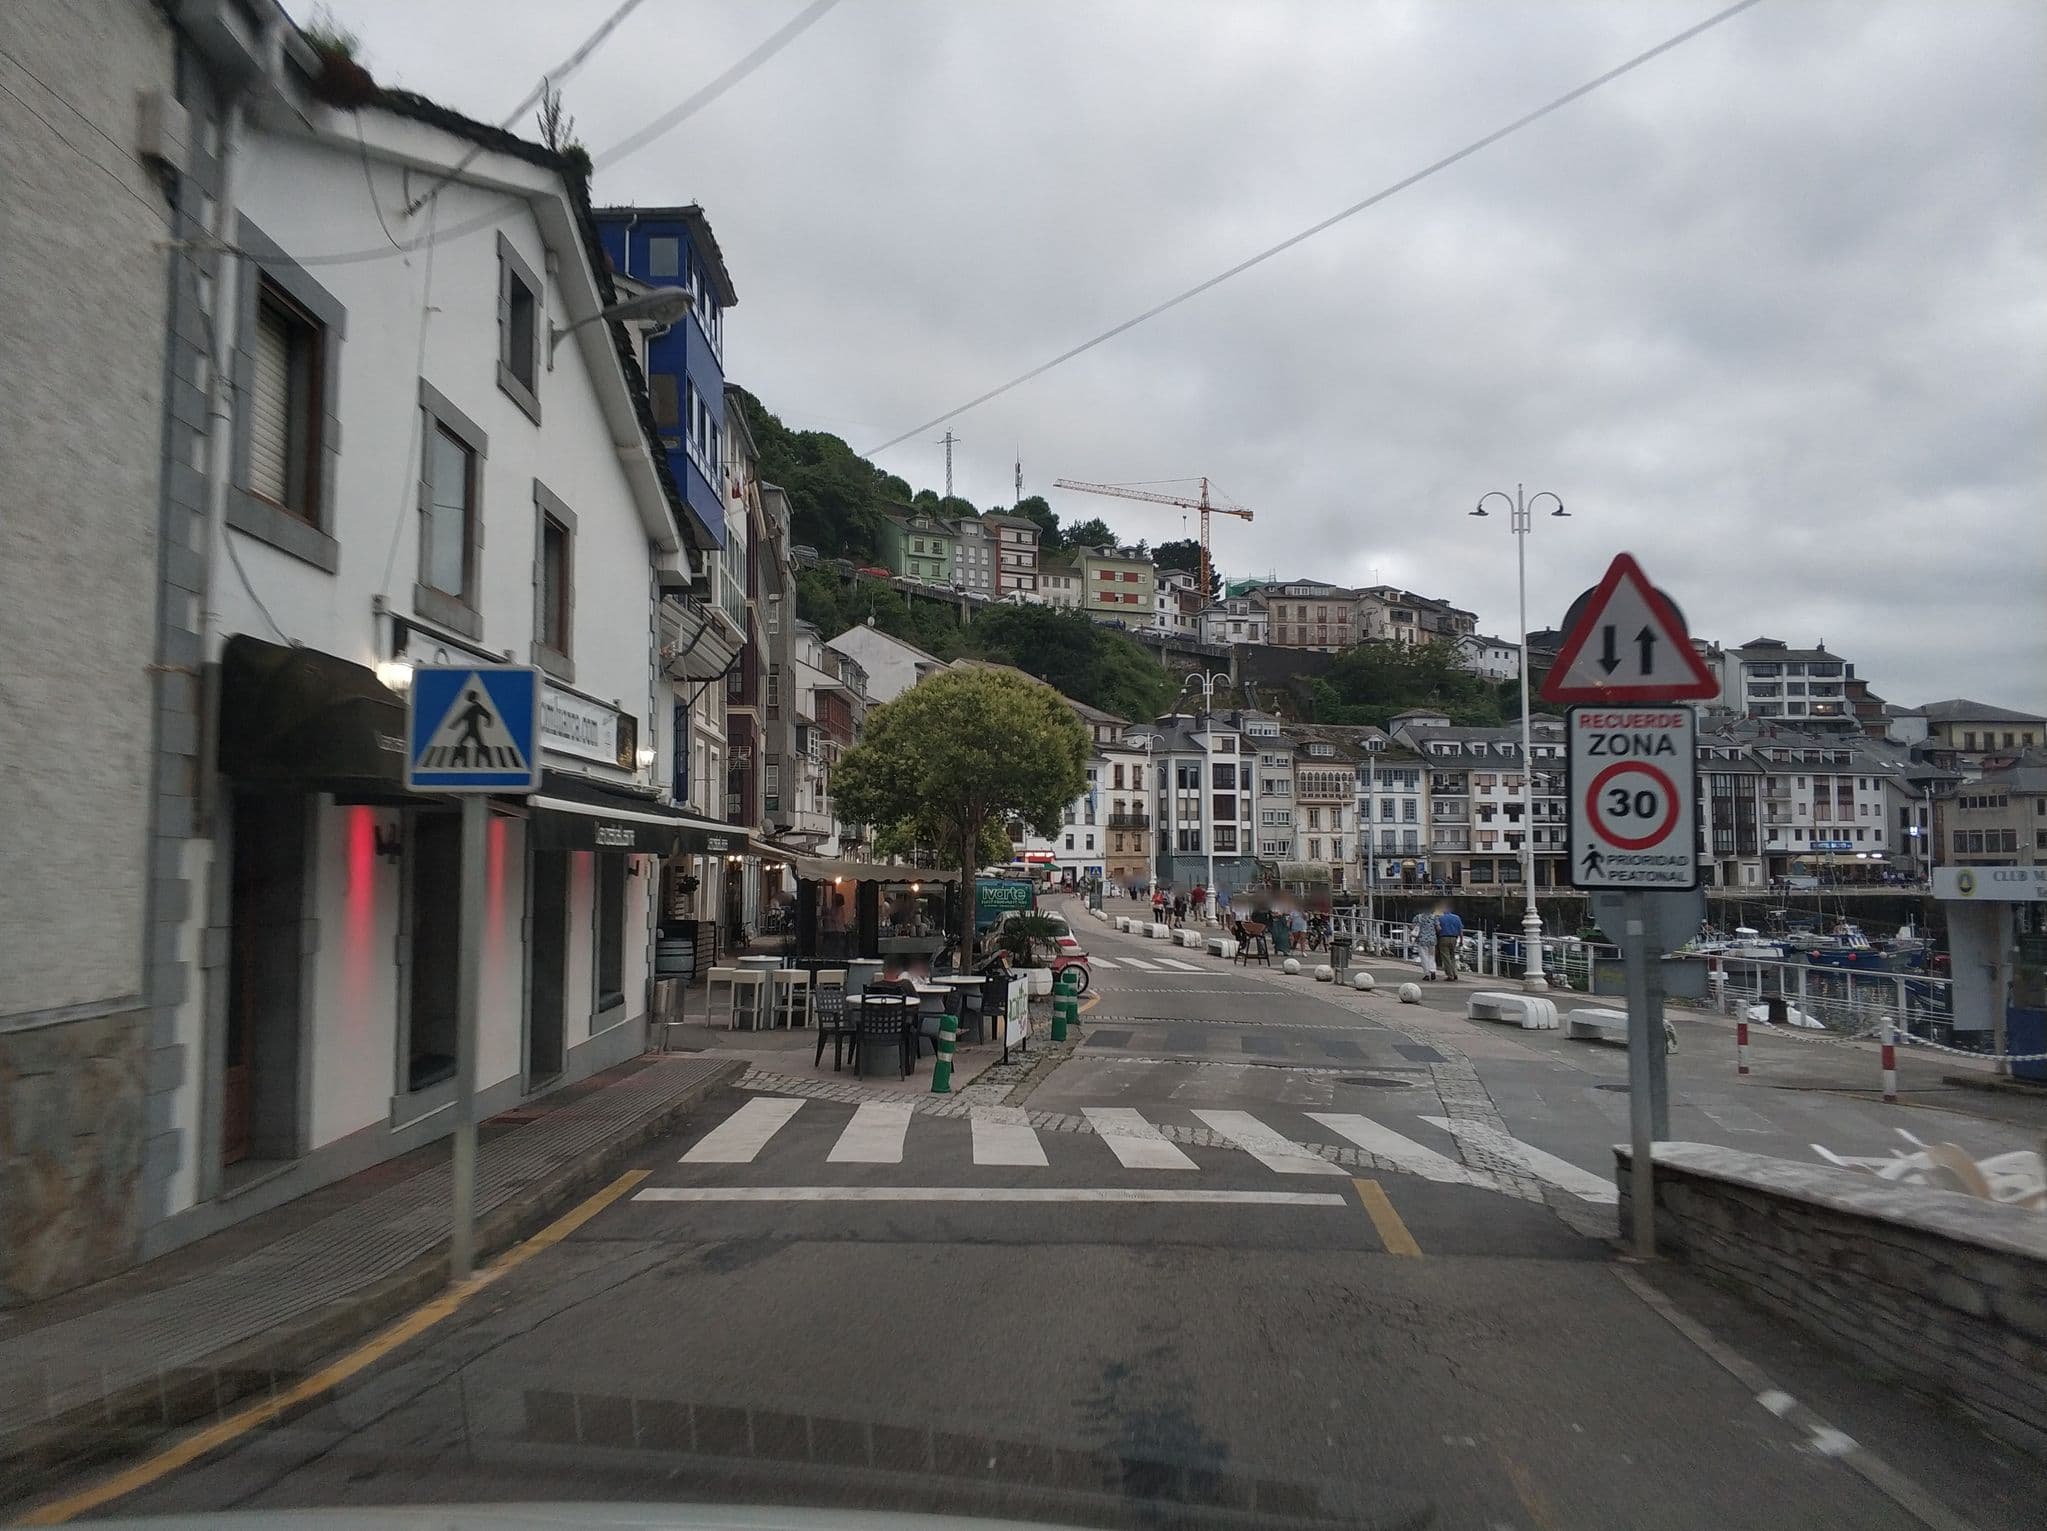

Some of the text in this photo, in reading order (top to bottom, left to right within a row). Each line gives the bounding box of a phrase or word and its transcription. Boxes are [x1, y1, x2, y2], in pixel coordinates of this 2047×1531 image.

[1579, 714, 1684, 728] RECUERDE
[1588, 733, 1677, 756] ZONA
[1607, 788, 1658, 819] 30
[1606, 855, 1689, 866] PRIORIDAD
[1608, 871, 1689, 882] PEATONAL
